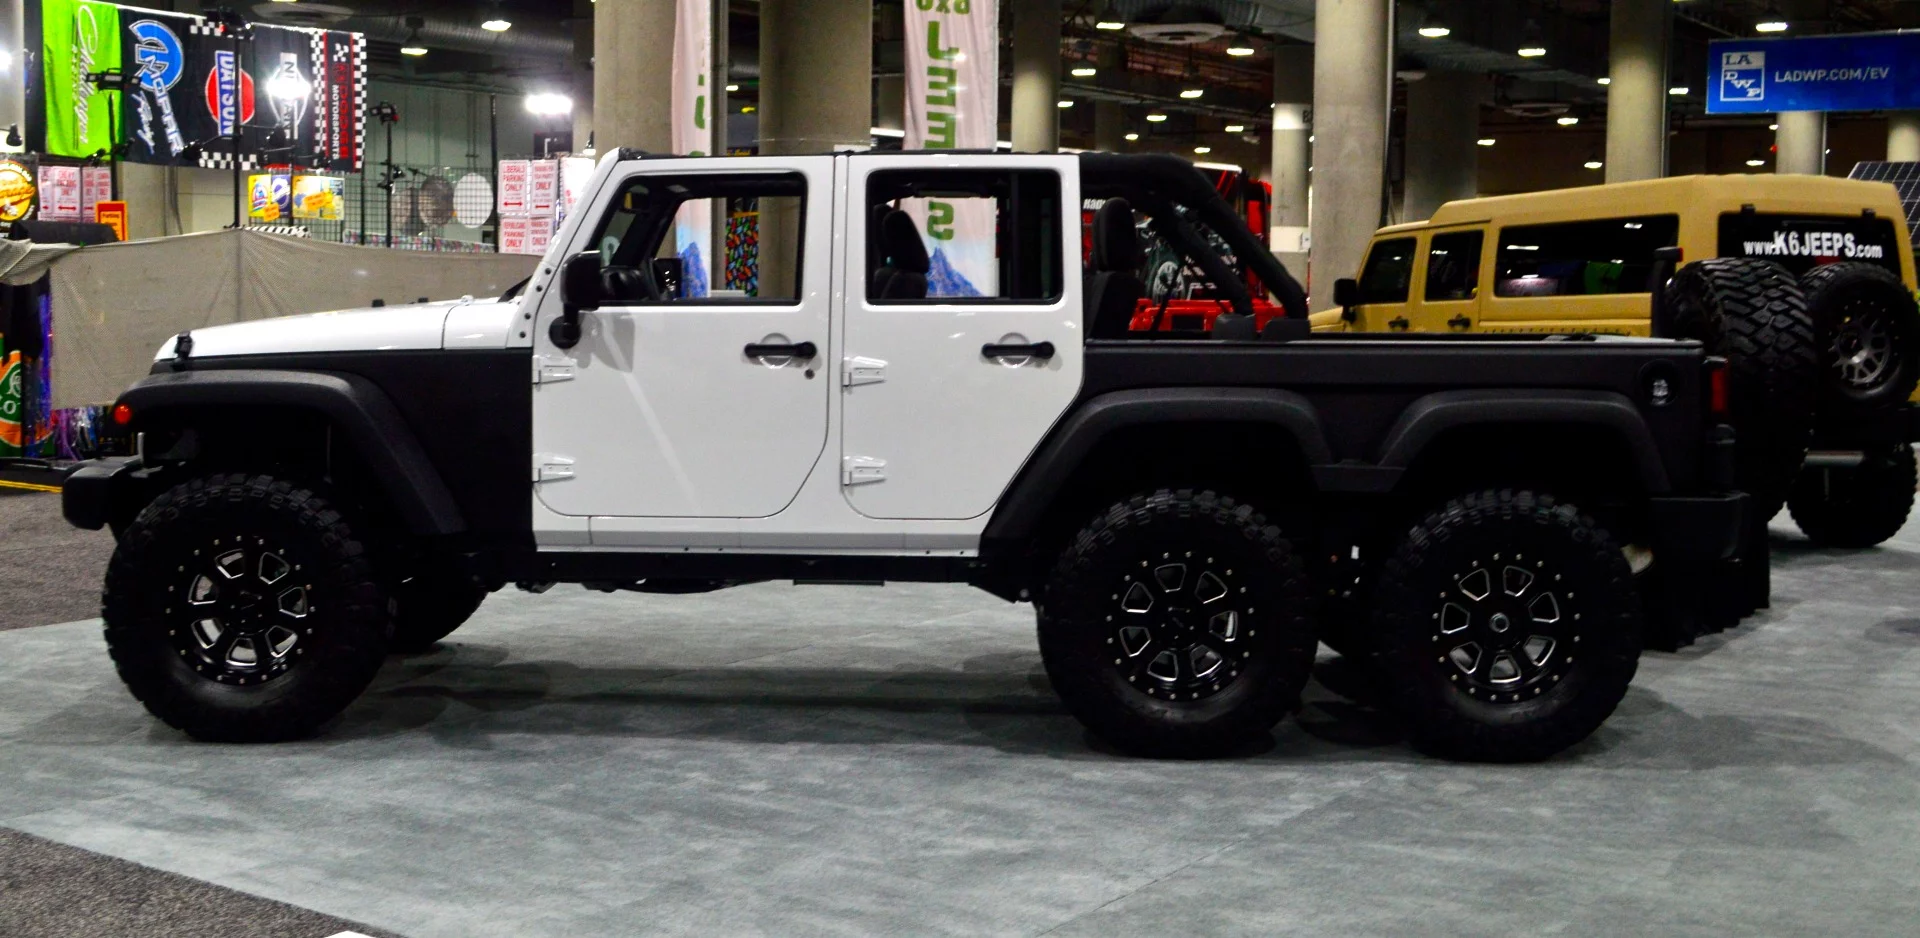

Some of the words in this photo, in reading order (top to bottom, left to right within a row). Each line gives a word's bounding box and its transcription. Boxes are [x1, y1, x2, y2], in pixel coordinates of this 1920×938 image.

[1724, 54, 1752, 66] LA
[74, 4, 98, 144] Challenger
[1774, 67, 1890, 83] LADWP.COM/EV
[145, 54, 185, 157] MOPAR
[219, 55, 236, 135] DATSUN
[332, 84, 340, 160] MOTORSPORTS
[340, 83, 349, 160] DODGE
[504, 183, 522, 191] ONLY
[536, 181, 552, 190] ONLY
[506, 239, 522, 247] ONLY
[532, 237, 547, 245] ONLY
[1743, 231, 1883, 258] www.K6JEEPS.com
